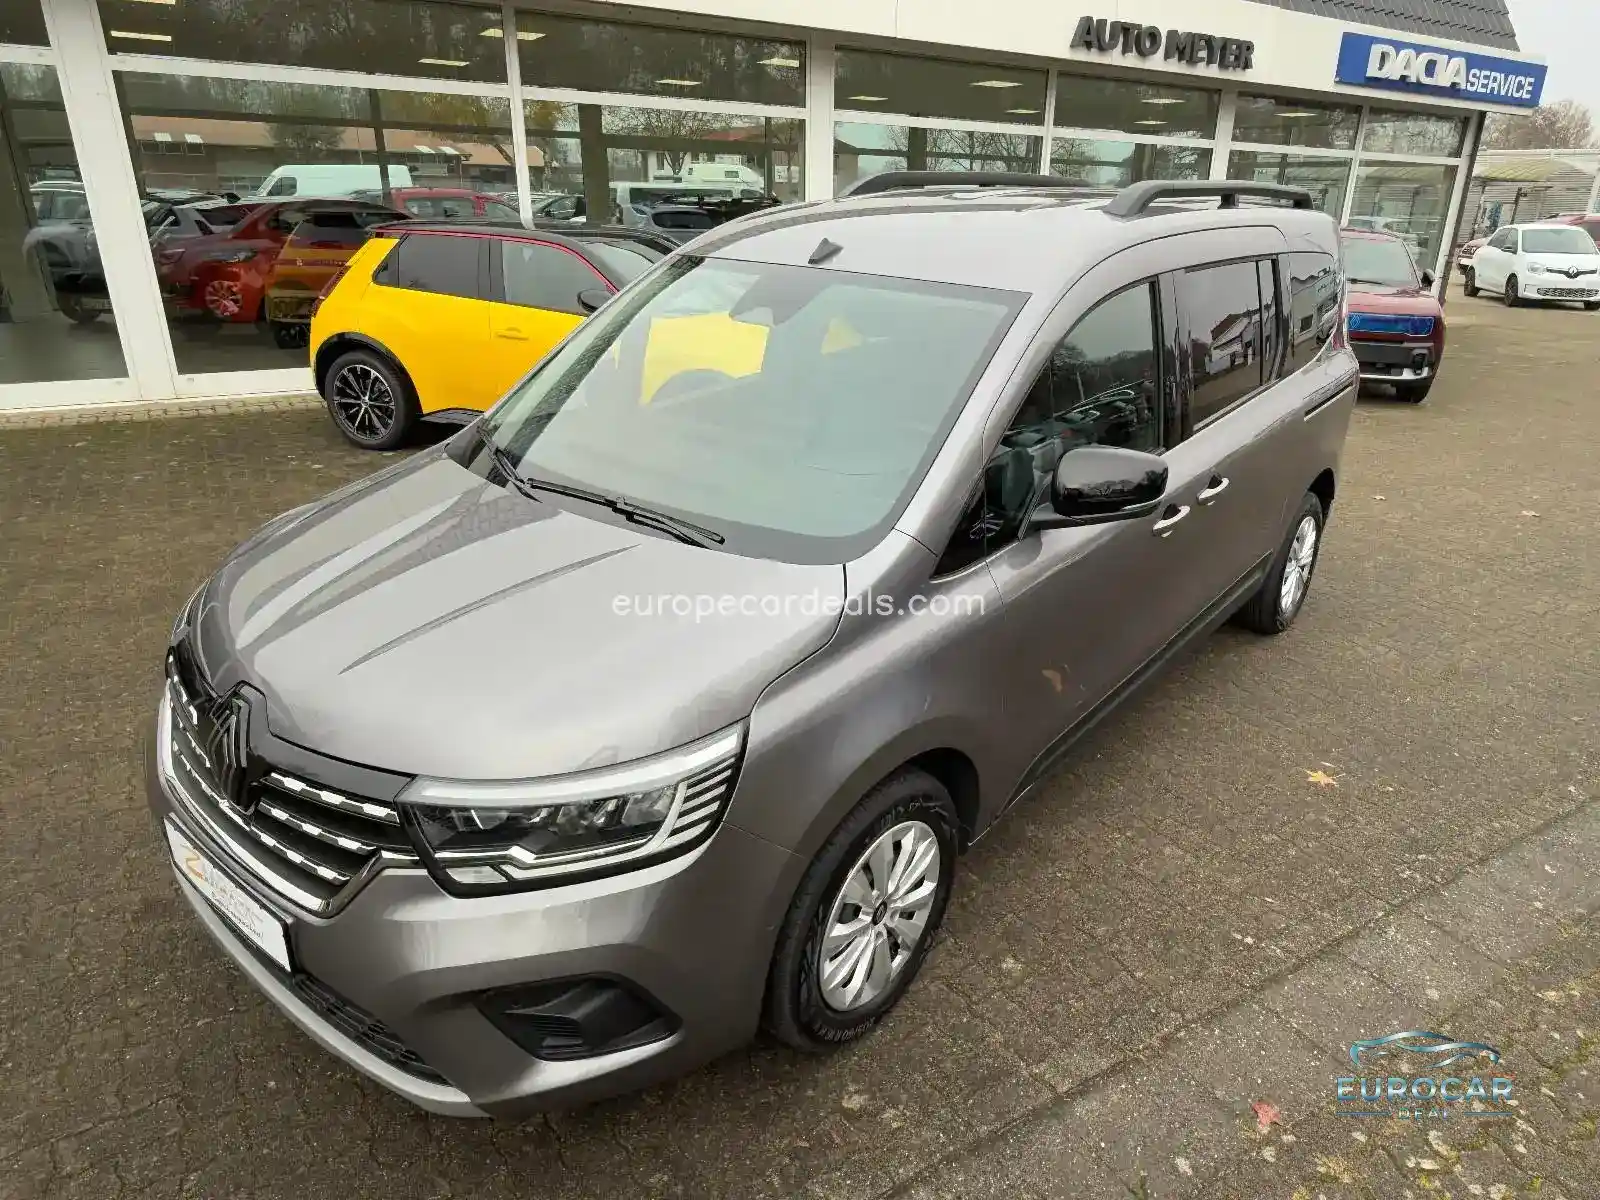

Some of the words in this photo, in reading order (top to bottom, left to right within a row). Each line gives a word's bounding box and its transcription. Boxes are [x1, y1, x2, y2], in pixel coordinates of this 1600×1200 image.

[1070, 16, 1162, 57] AUTO
[1164, 30, 1255, 70] MEYER
[1366, 44, 1468, 90] DACIA
[1467, 68, 1535, 99] SERVICE
